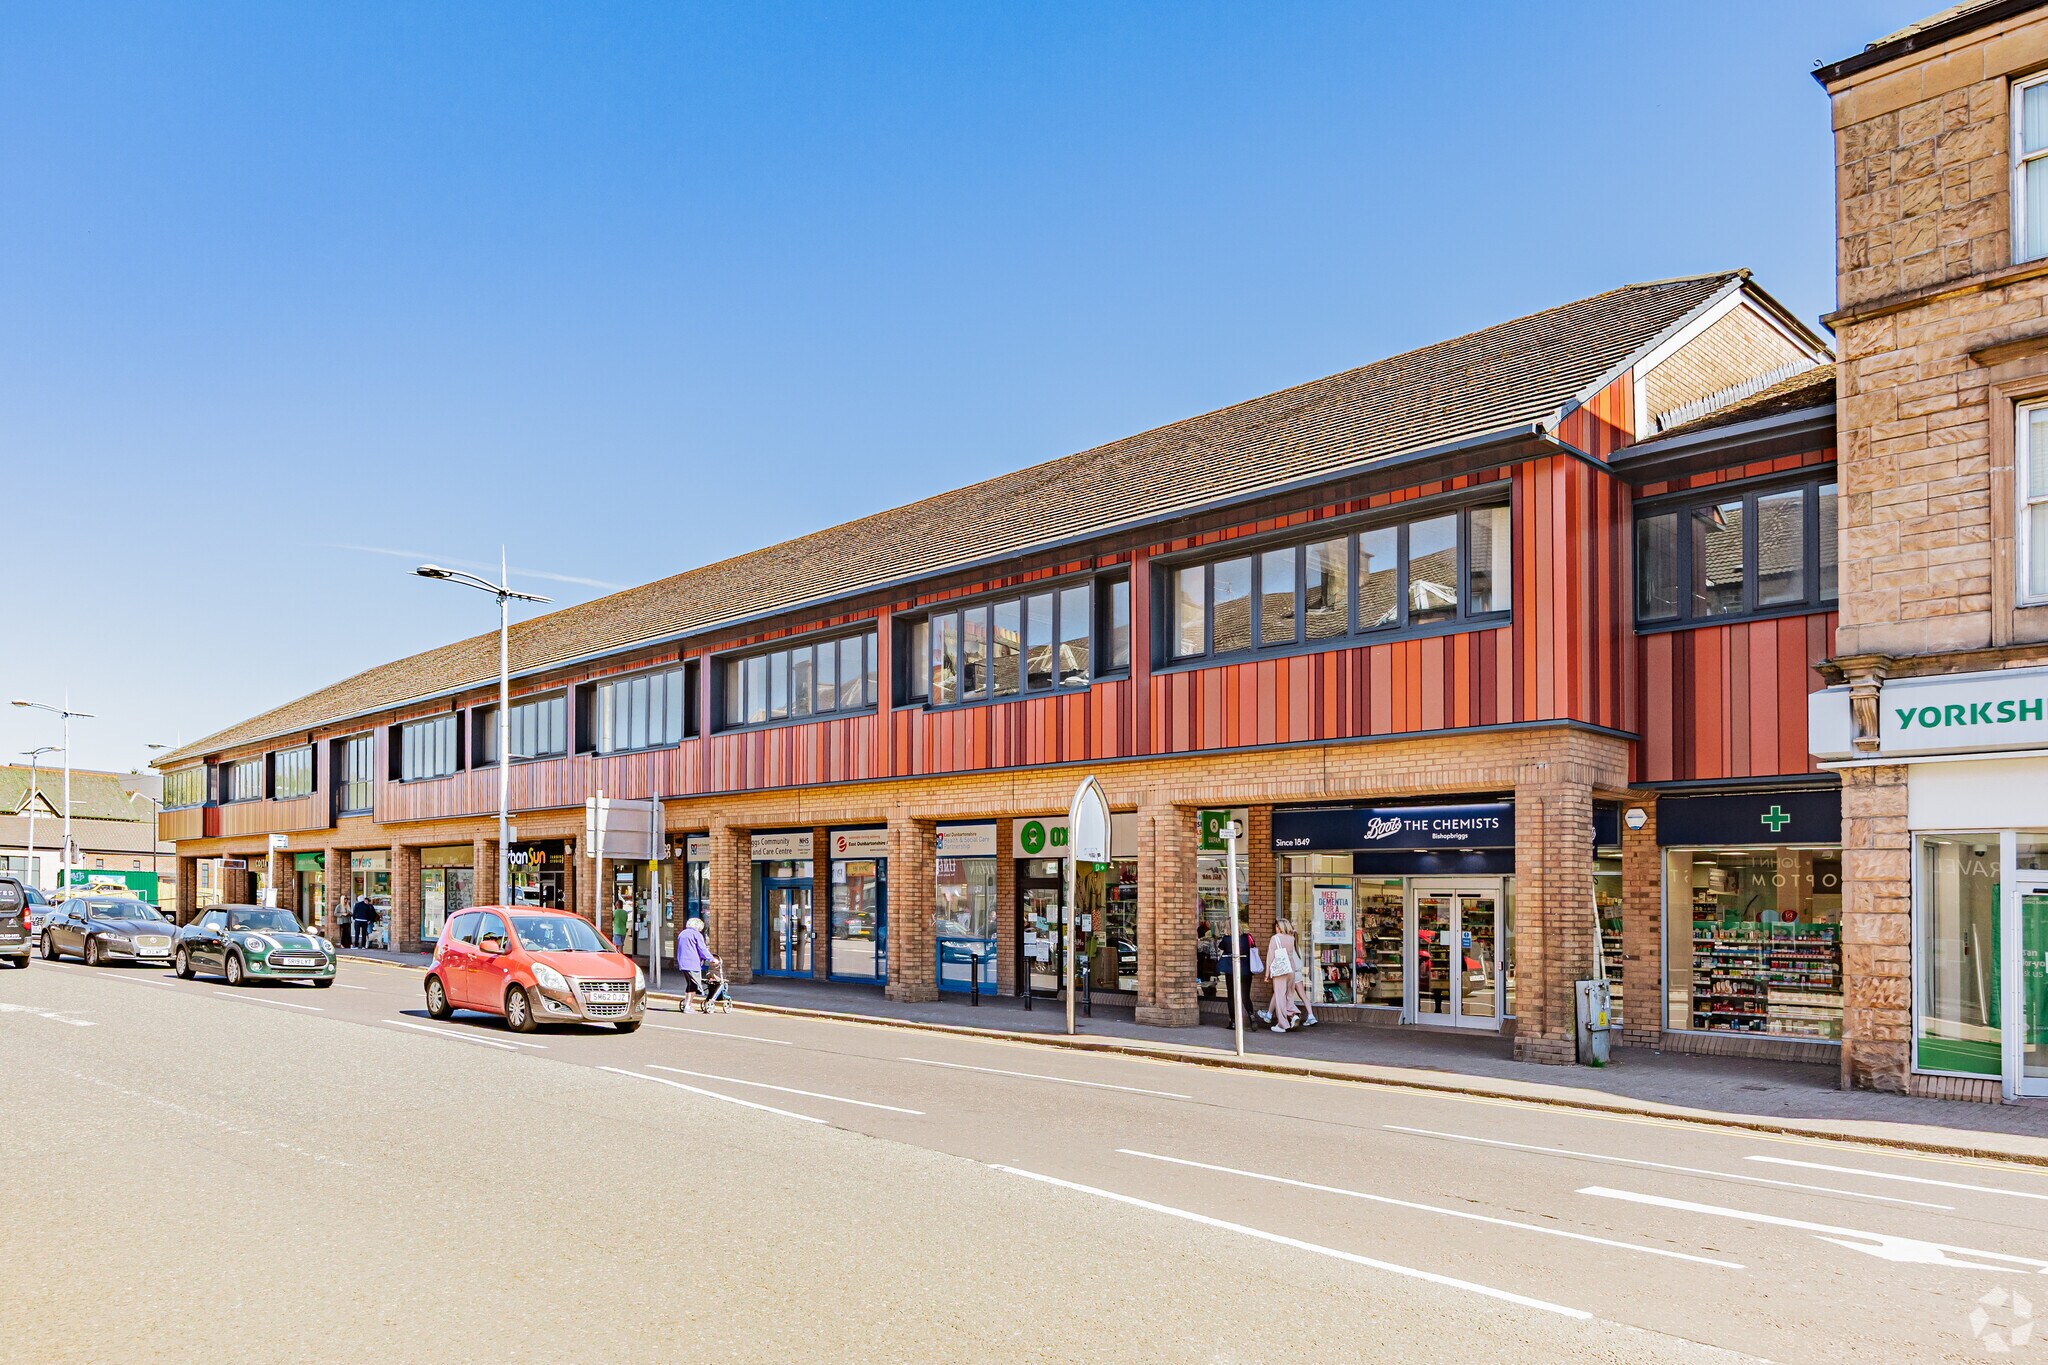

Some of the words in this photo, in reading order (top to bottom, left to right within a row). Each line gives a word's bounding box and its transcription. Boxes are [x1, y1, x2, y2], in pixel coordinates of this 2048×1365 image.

[1895, 698, 2048, 730] YORKSH
[1364, 817, 1402, 840] Boots
[1404, 820, 1428, 831] THE
[1433, 818, 1499, 830] CHEMISTS
[761, 838, 790, 846] Community
[1276, 839, 1293, 847] Since
[1294, 838, 1310, 846] 1849
[528, 847, 546, 867] Sun
[1319, 898, 1349, 906] DEMENTIA
[1324, 912, 1346, 920] COFFEE
